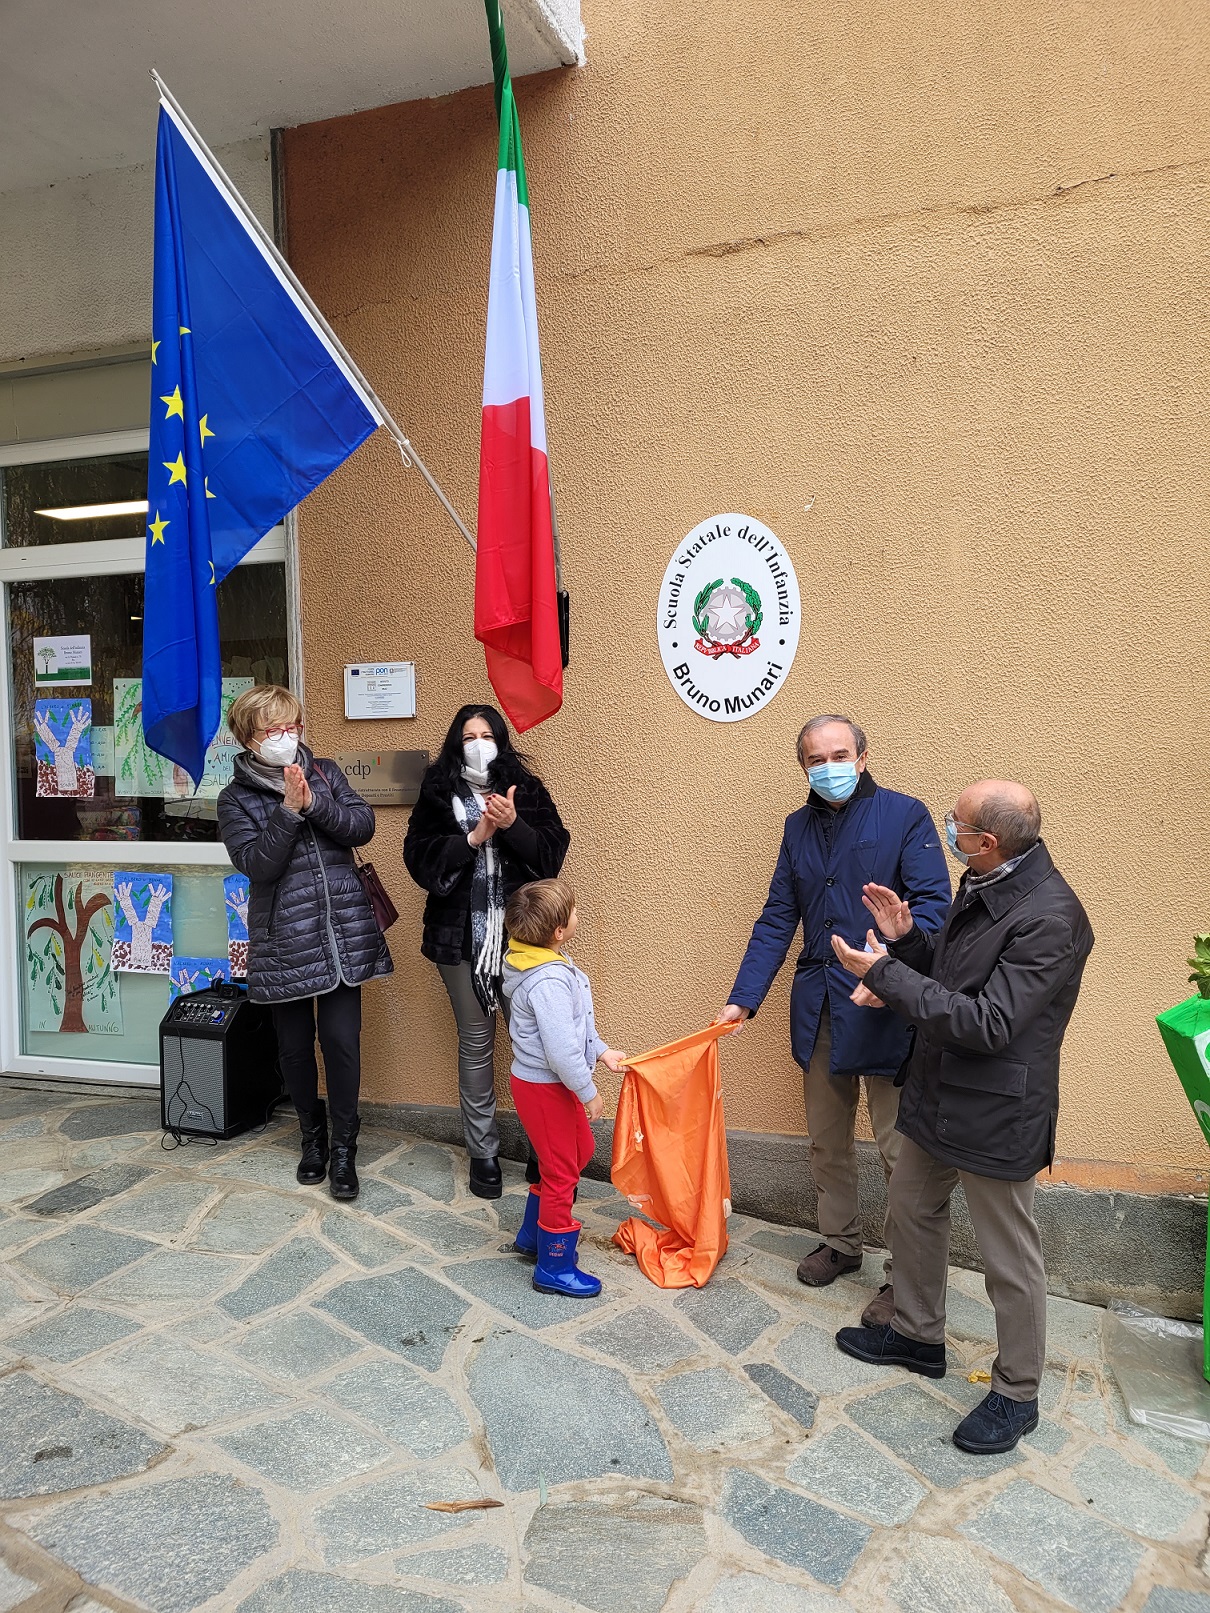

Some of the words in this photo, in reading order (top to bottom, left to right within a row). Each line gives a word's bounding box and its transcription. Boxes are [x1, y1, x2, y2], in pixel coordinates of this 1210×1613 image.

[663, 573, 685, 629] Scuola
[677, 524, 732, 569] Statale
[737, 525, 794, 626] dell'Infanzia
[375, 667, 388, 675] pon
[672, 662, 721, 712] Bruno
[724, 661, 783, 714] Munari
[344, 759, 371, 779] cdp
